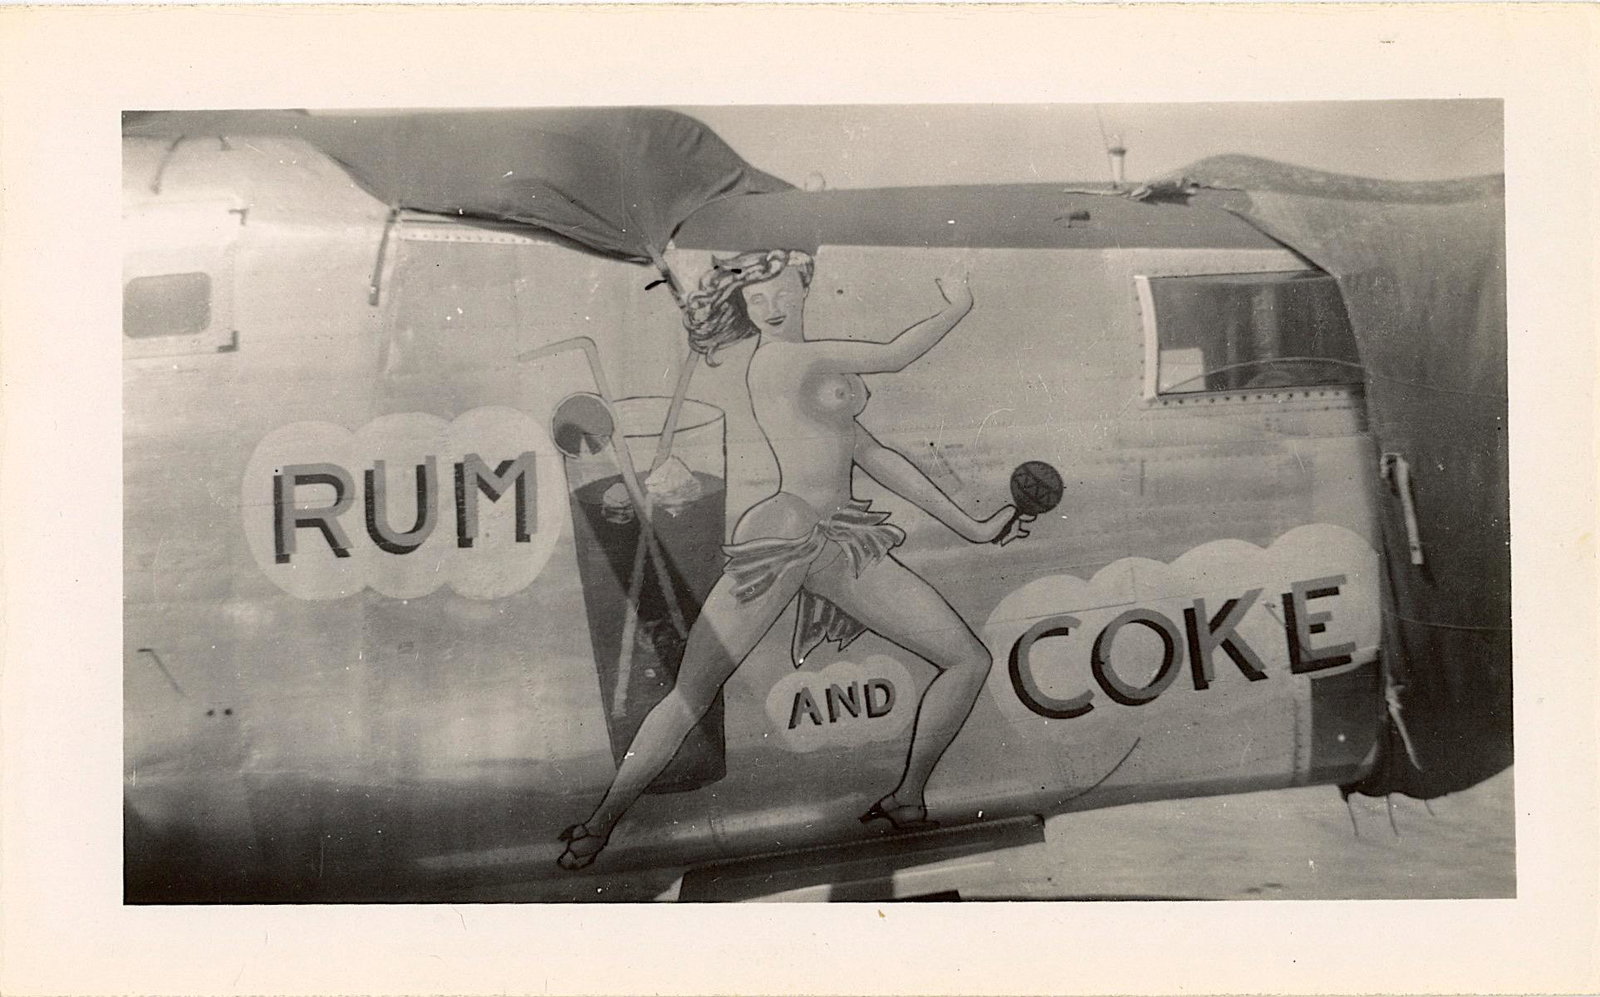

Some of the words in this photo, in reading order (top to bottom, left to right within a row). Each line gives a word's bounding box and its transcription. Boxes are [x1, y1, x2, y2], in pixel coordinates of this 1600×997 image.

[273, 452, 538, 564] RUM
[788, 677, 896, 729] AND
[1008, 575, 1355, 719] COKE
